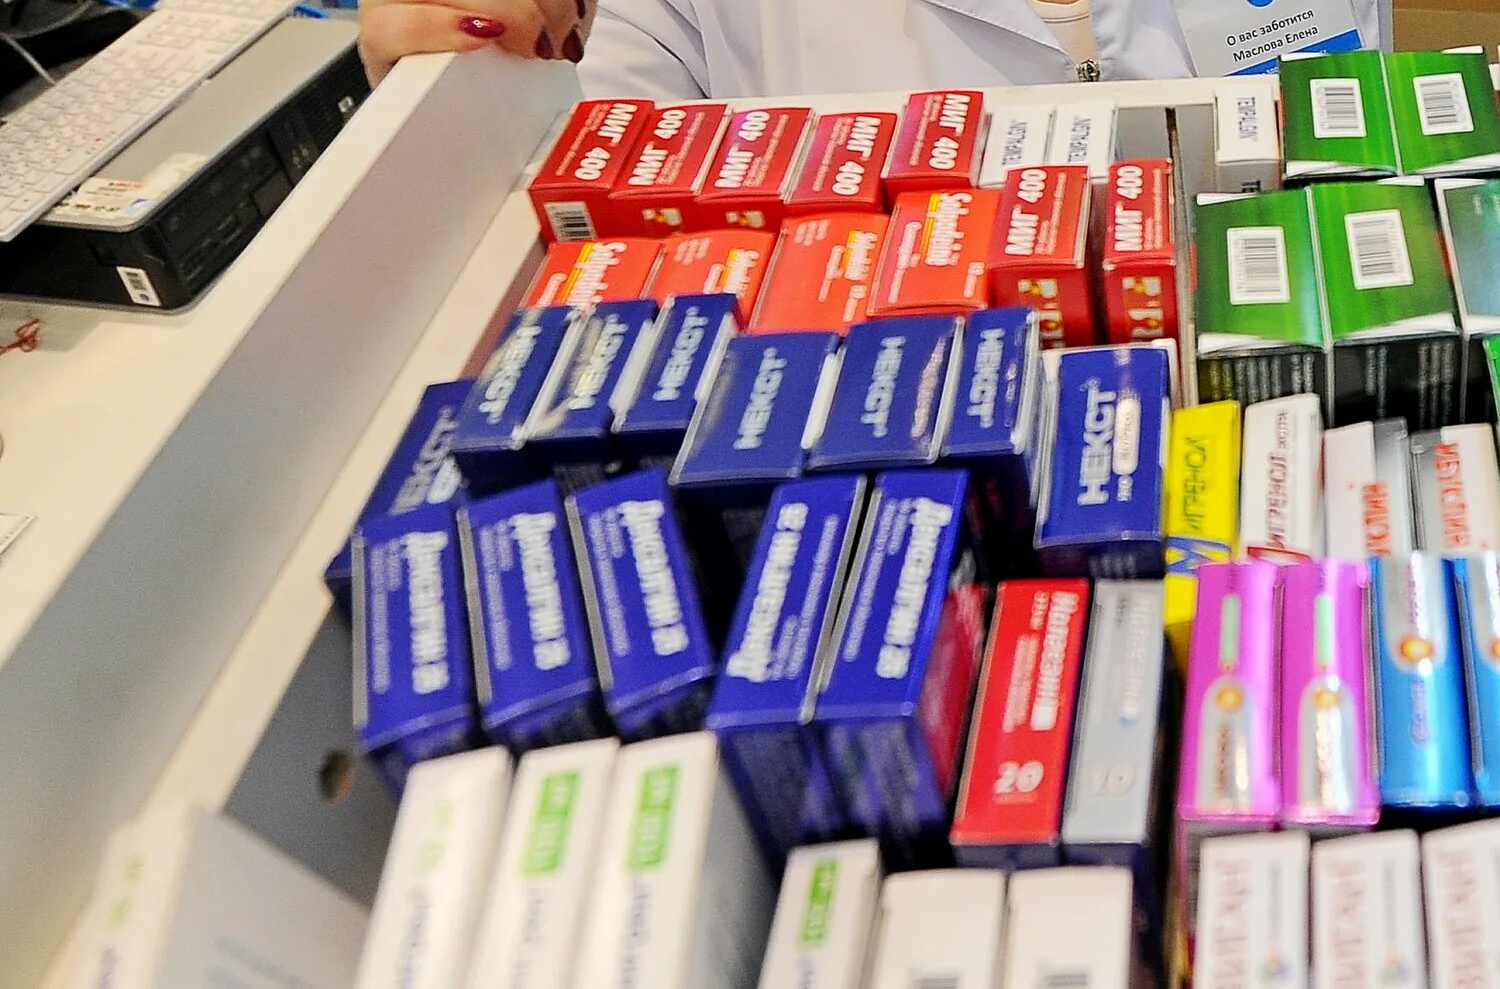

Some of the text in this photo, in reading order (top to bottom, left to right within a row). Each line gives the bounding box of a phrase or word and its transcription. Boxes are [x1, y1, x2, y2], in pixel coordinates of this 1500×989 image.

[1226, 9, 1315, 47] О вас заботится
[1233, 25, 1319, 62] Маслова Елена
[653, 109, 686, 139] 400
[737, 111, 771, 142] 400
[574, 147, 611, 180] 400
[928, 136, 960, 170] 400
[831, 162, 866, 196] 400
[1016, 168, 1048, 204] 400
[1116, 165, 1144, 200] 400
[1077, 388, 1118, 506] НЕКСТ
[994, 761, 1044, 796] 20
